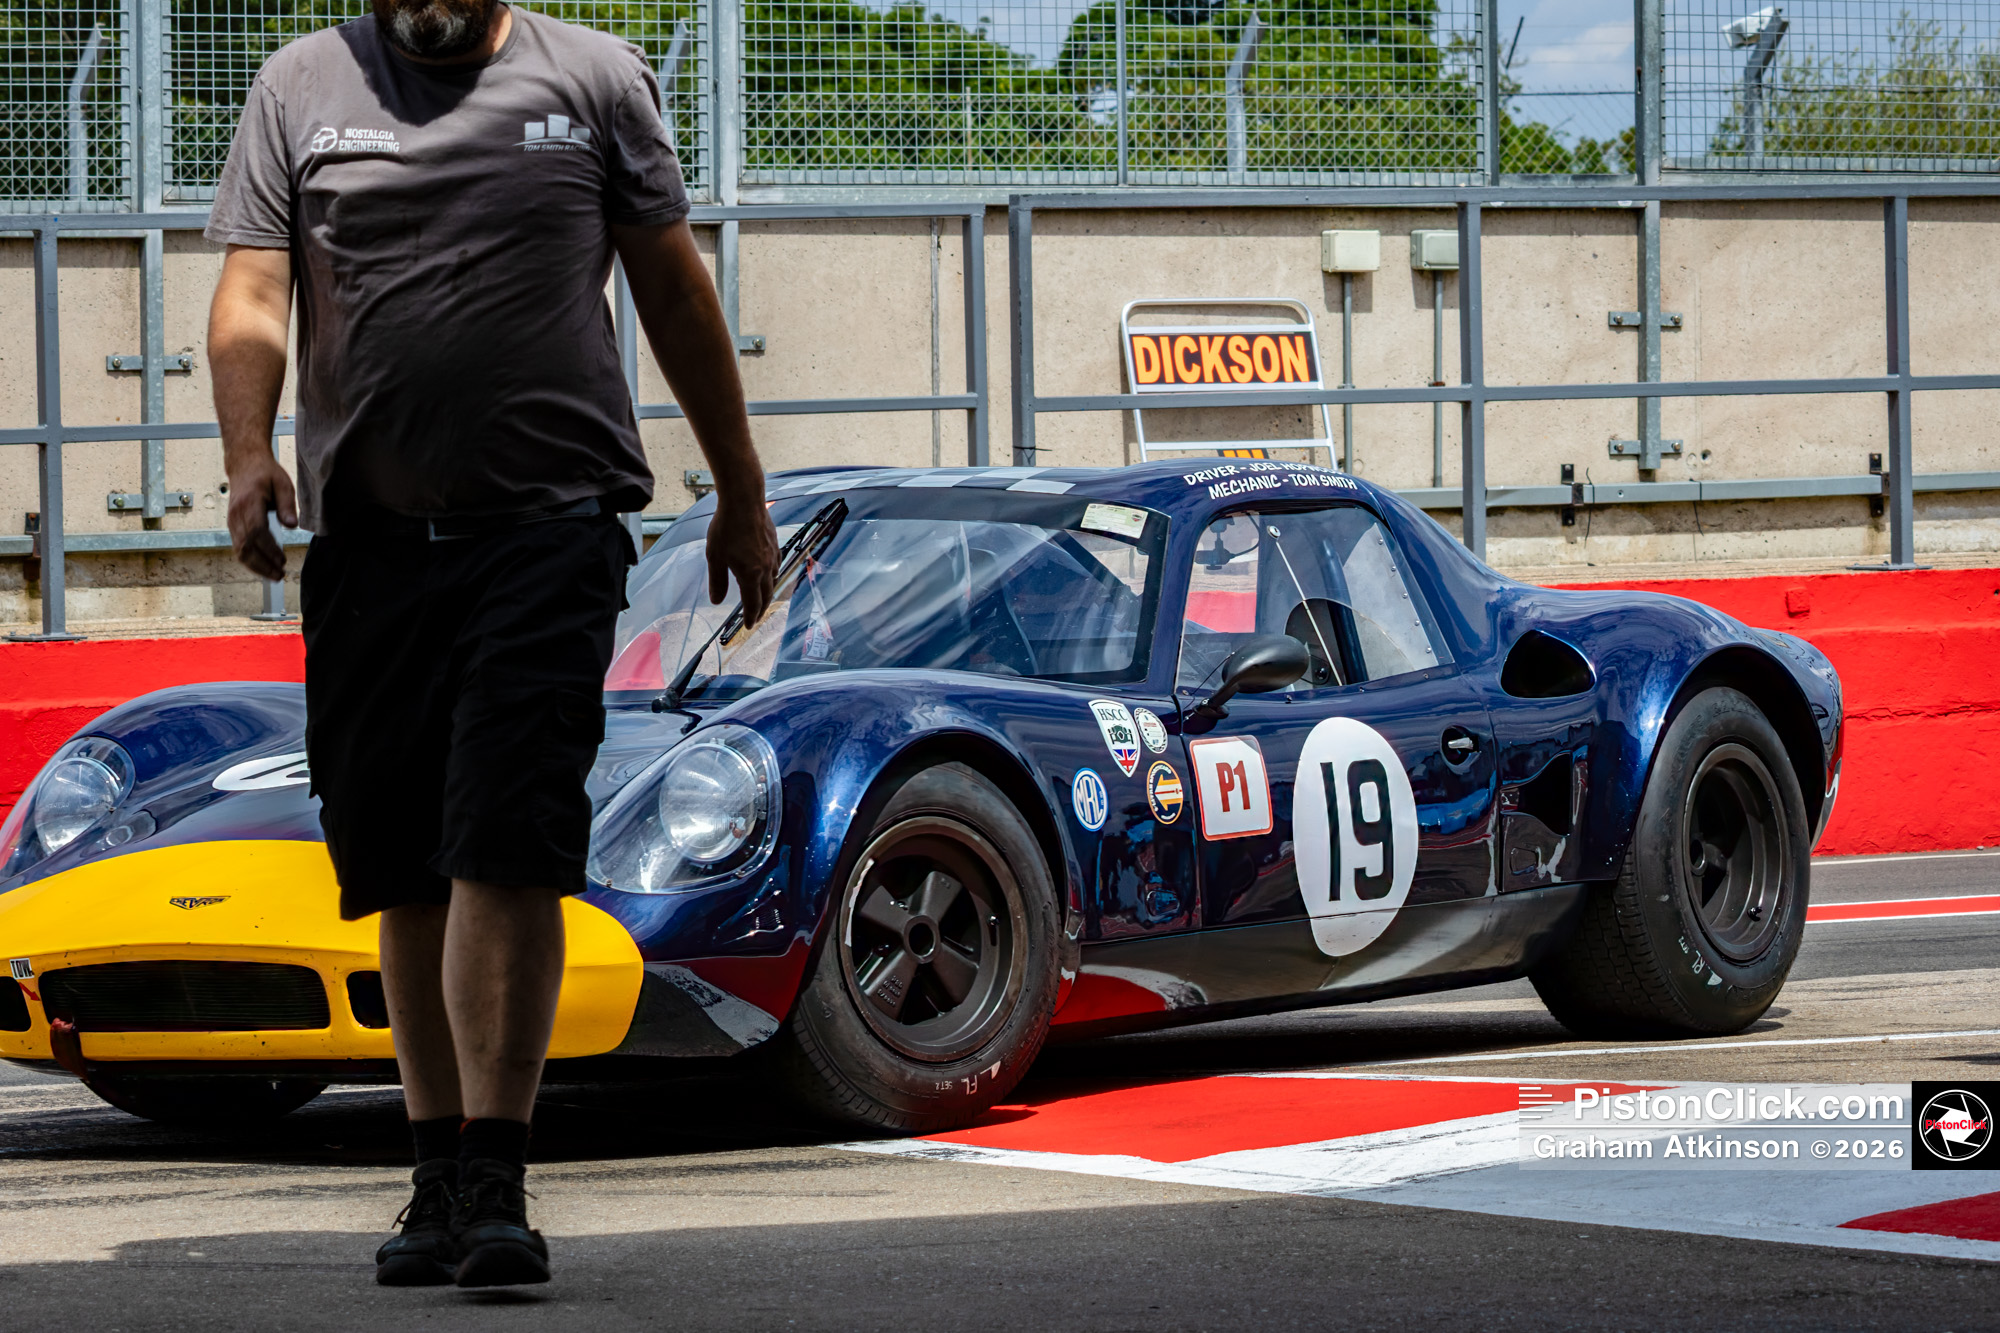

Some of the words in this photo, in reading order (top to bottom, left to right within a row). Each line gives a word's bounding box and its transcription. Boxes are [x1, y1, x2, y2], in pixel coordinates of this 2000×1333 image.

[339, 140, 400, 152] ENGINEERING
[345, 128, 394, 140] NOSTALGIA
[524, 144, 540, 152] TOM
[1132, 335, 1310, 384] DICKSON
[1183, 464, 1240, 486] DRIVER
[1250, 462, 1282, 472] JOEL
[1208, 474, 1281, 500] MECHANIC
[1288, 474, 1320, 487] TOM
[1321, 474, 1358, 490] SMITH
[1097, 708, 1128, 721] HSCC
[1216, 760, 1251, 813] P1
[1076, 775, 1103, 824] MRL
[1320, 758, 1395, 901] 19
[961, 1074, 978, 1095] FL
